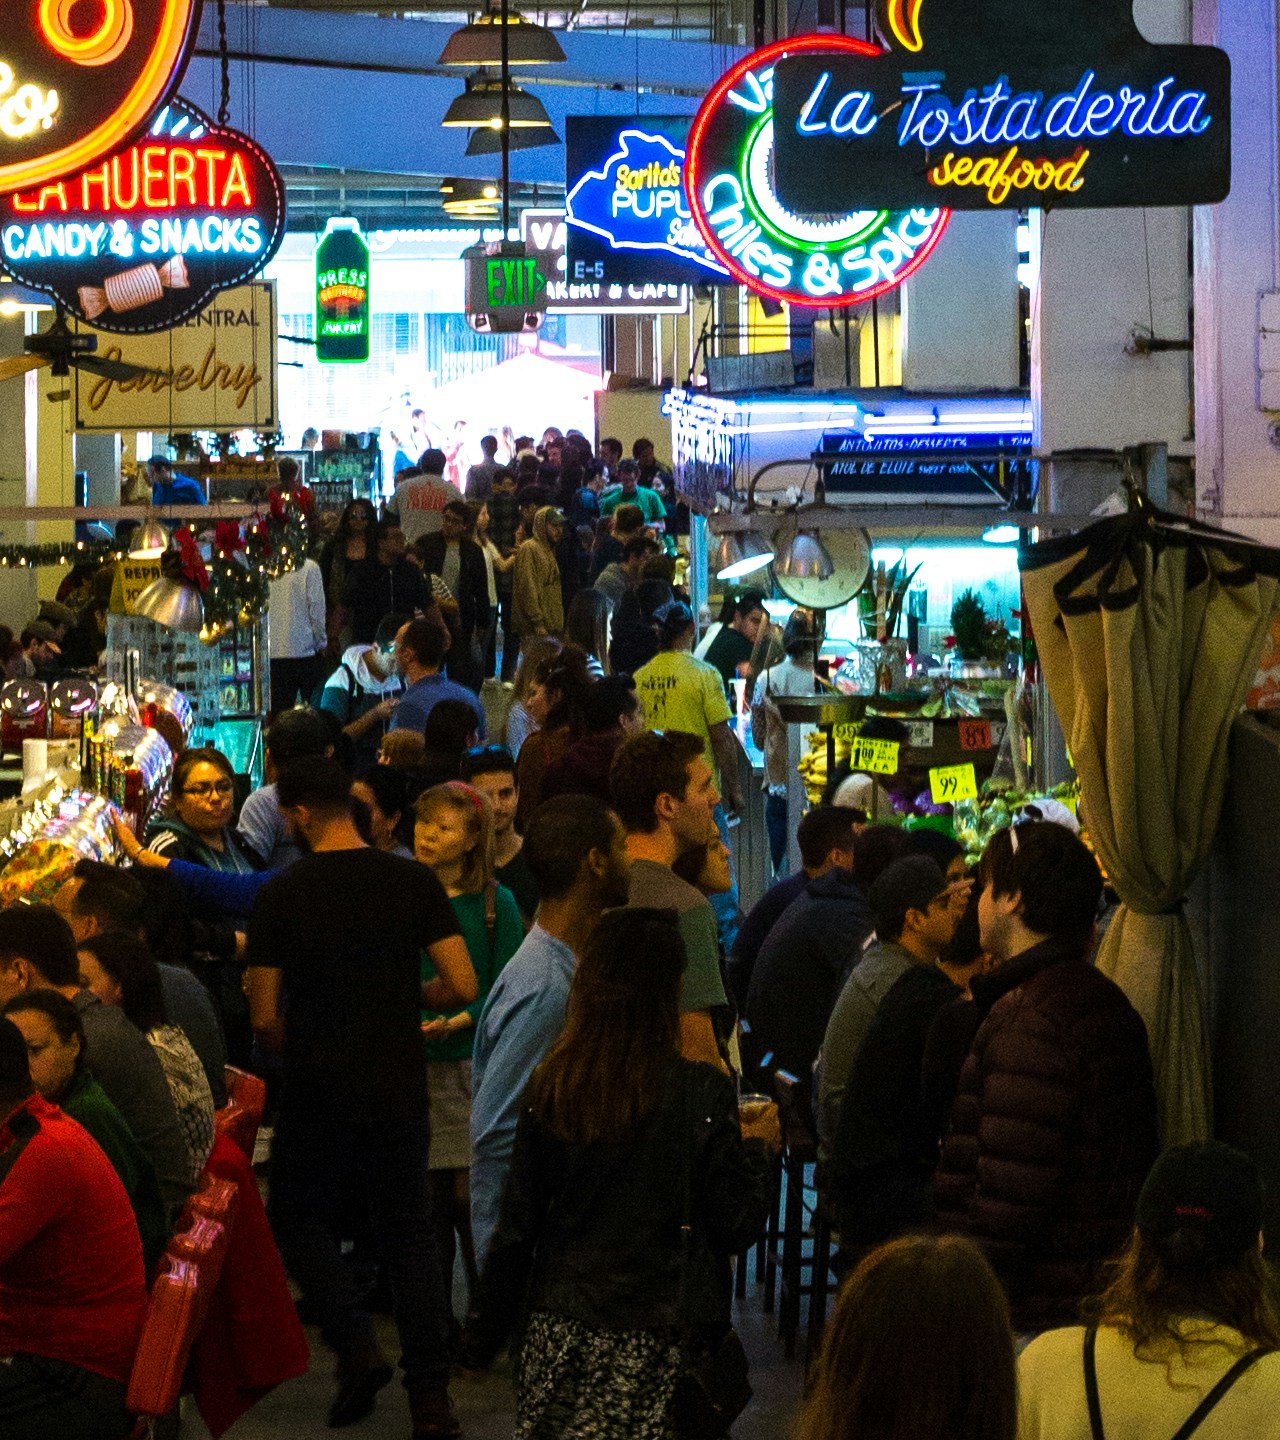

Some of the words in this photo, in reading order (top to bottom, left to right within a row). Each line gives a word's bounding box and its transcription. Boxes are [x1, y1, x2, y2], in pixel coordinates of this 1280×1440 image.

[797, 72, 877, 134] La
[898, 69, 1212, 147] Tostadería
[82, 145, 252, 212] HUERTA
[929, 145, 1089, 204] seafood
[3, 221, 106, 259] CANDY
[109, 217, 134, 257] &
[140, 215, 263, 254] SNACKS
[704, 173, 793, 288] Chiles
[802, 250, 843, 294] &
[318, 267, 367, 289] PRESS
[486, 258, 538, 308] EXIT
[574, 258, 604, 279] E-5
[180, 308, 260, 328] ENTRAL
[939, 776, 958, 797] 99
